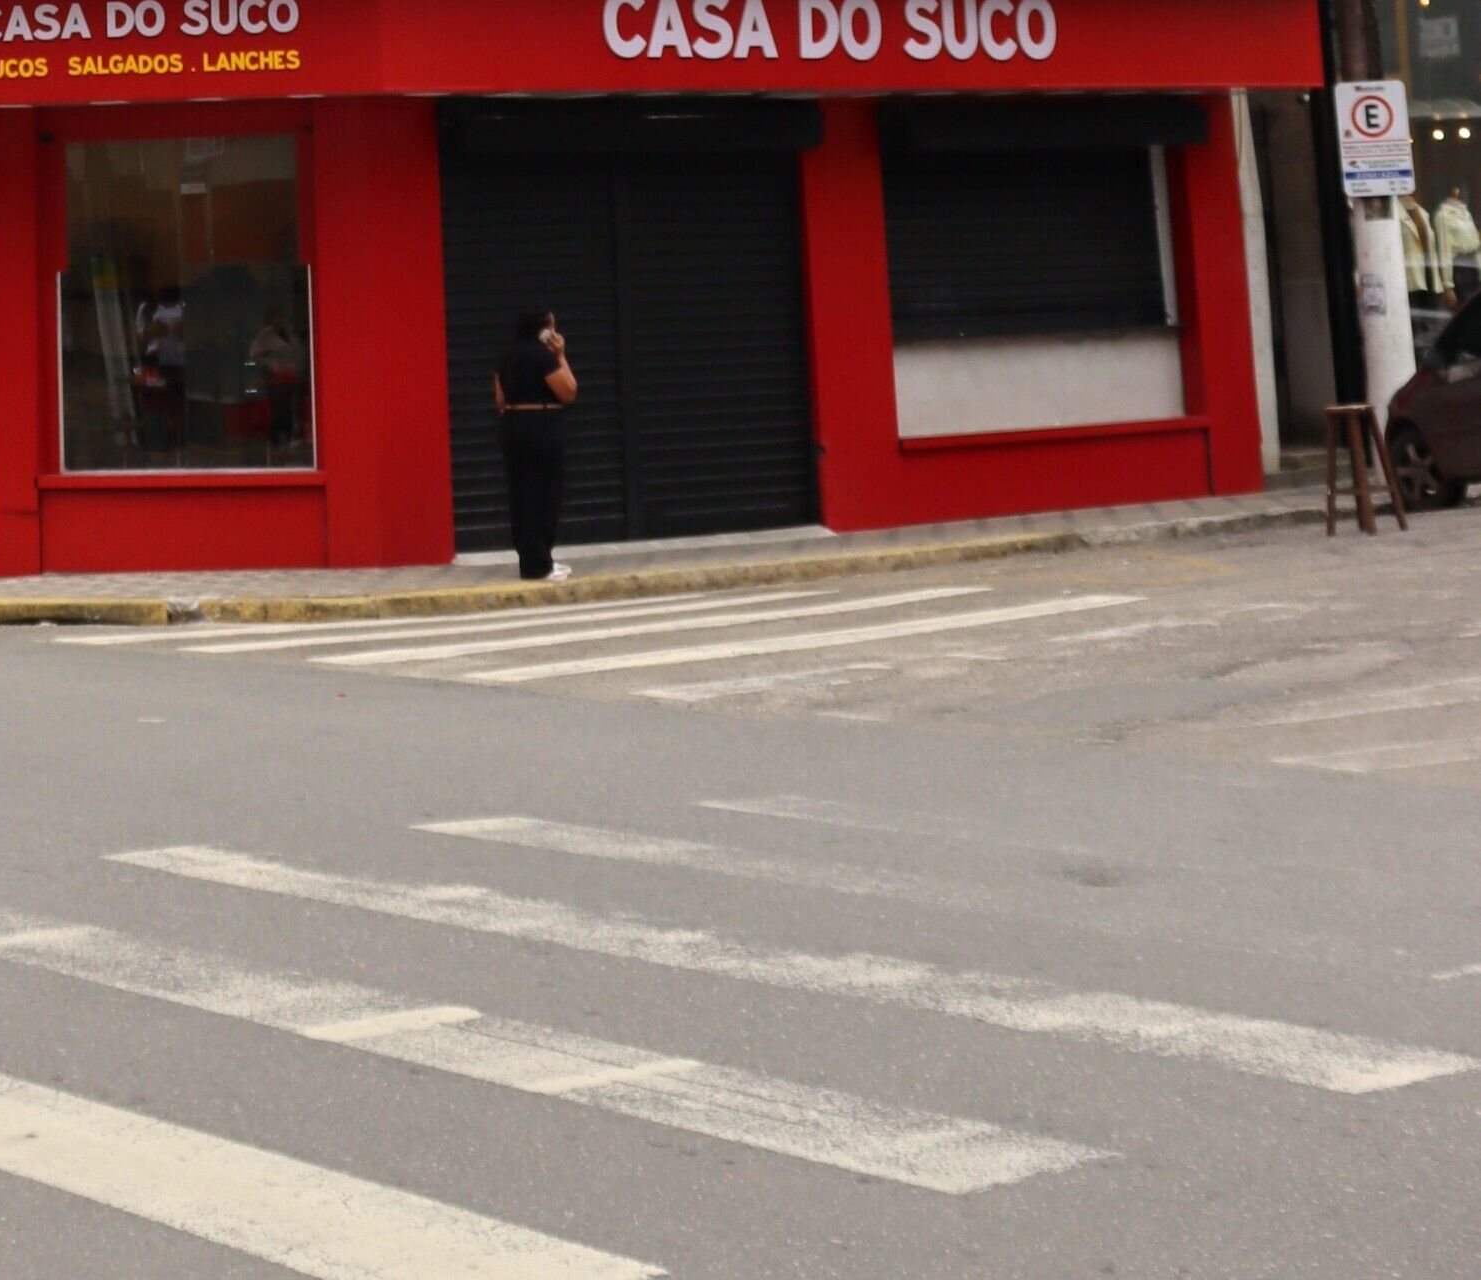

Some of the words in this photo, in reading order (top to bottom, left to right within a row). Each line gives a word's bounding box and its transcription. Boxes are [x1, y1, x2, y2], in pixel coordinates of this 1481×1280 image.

[106, 0, 166, 38] DO
[68, 54, 184, 76] SALGADOS
[202, 49, 301, 72] LANCHES
[1365, 104, 1380, 129] E
